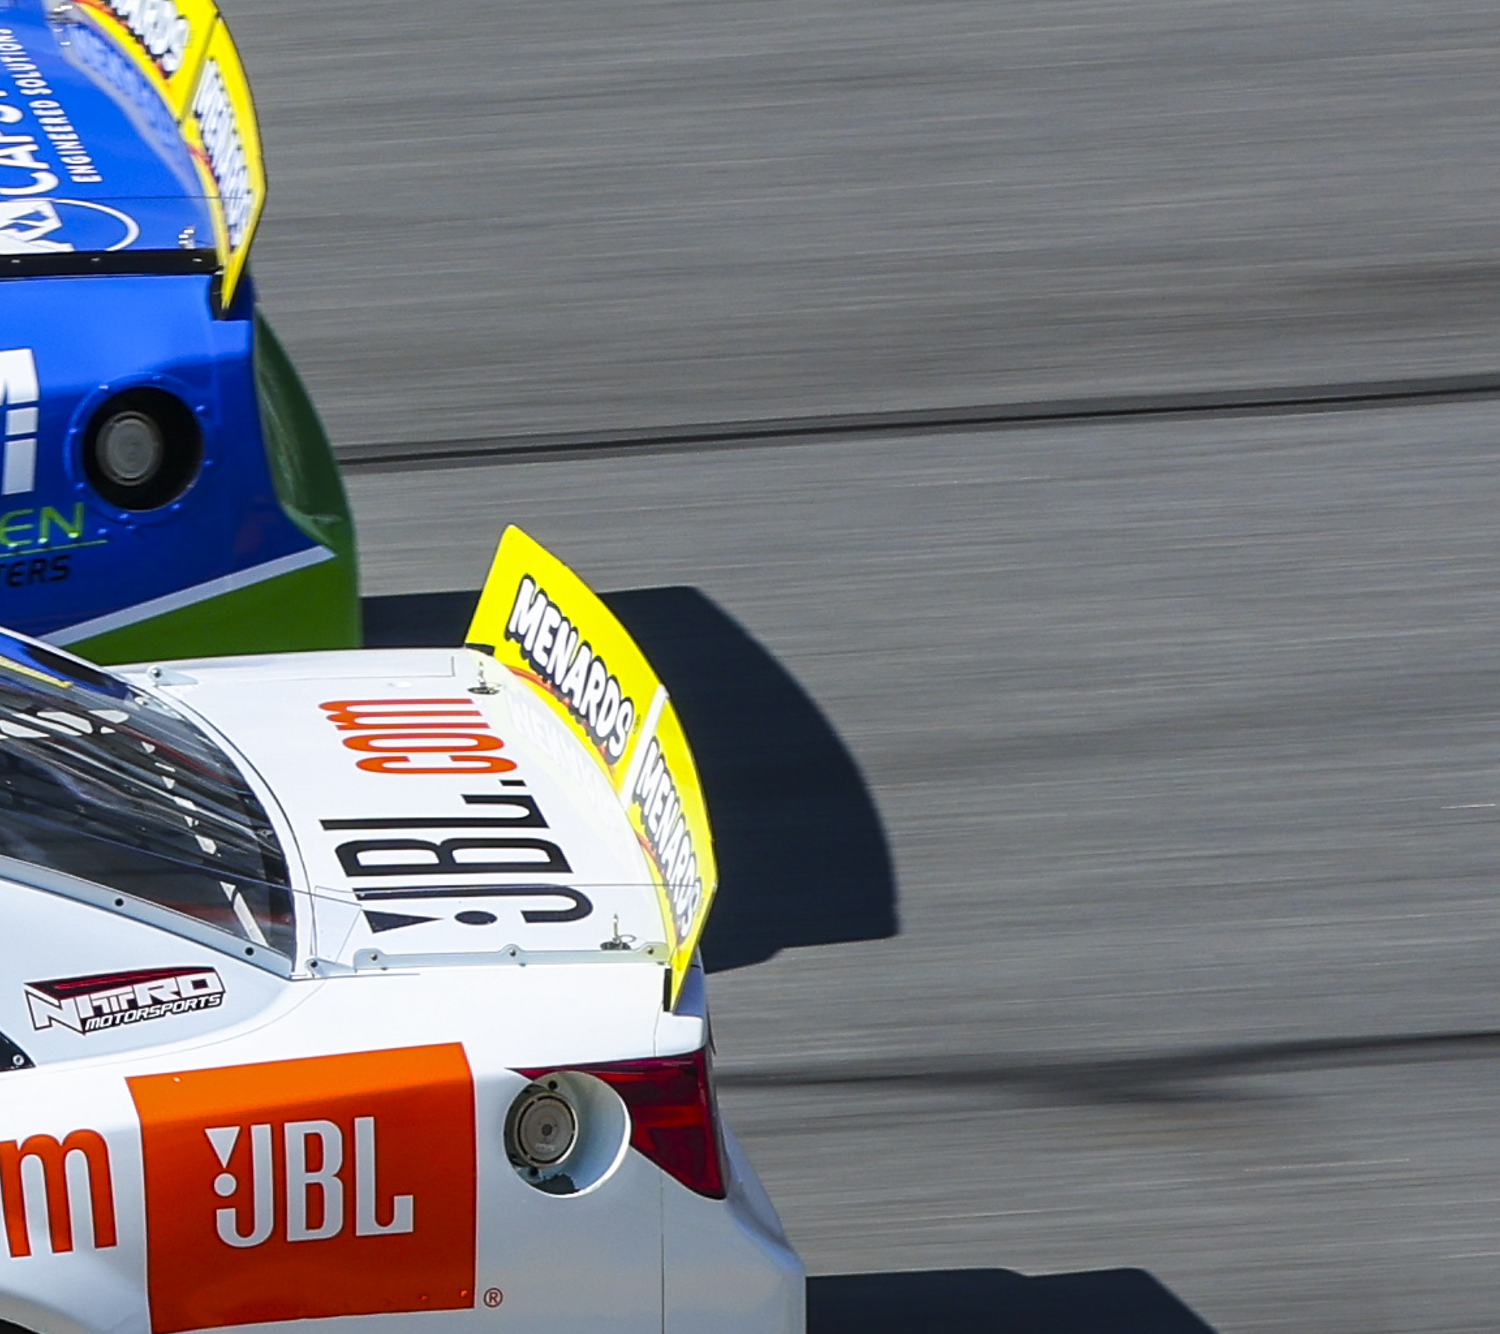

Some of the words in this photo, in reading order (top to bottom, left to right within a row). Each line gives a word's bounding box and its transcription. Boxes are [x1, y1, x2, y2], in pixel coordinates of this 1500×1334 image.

[29, 100, 103, 184] ENGINEERED
[506, 577, 635, 762] MENARDS
[318, 697, 594, 934] JBL.com
[636, 740, 703, 939] MENARDS
[26, 972, 225, 1034] NITRO
[85, 994, 222, 1032] MOTORSPORTS
[206, 1116, 413, 1249] JBL
